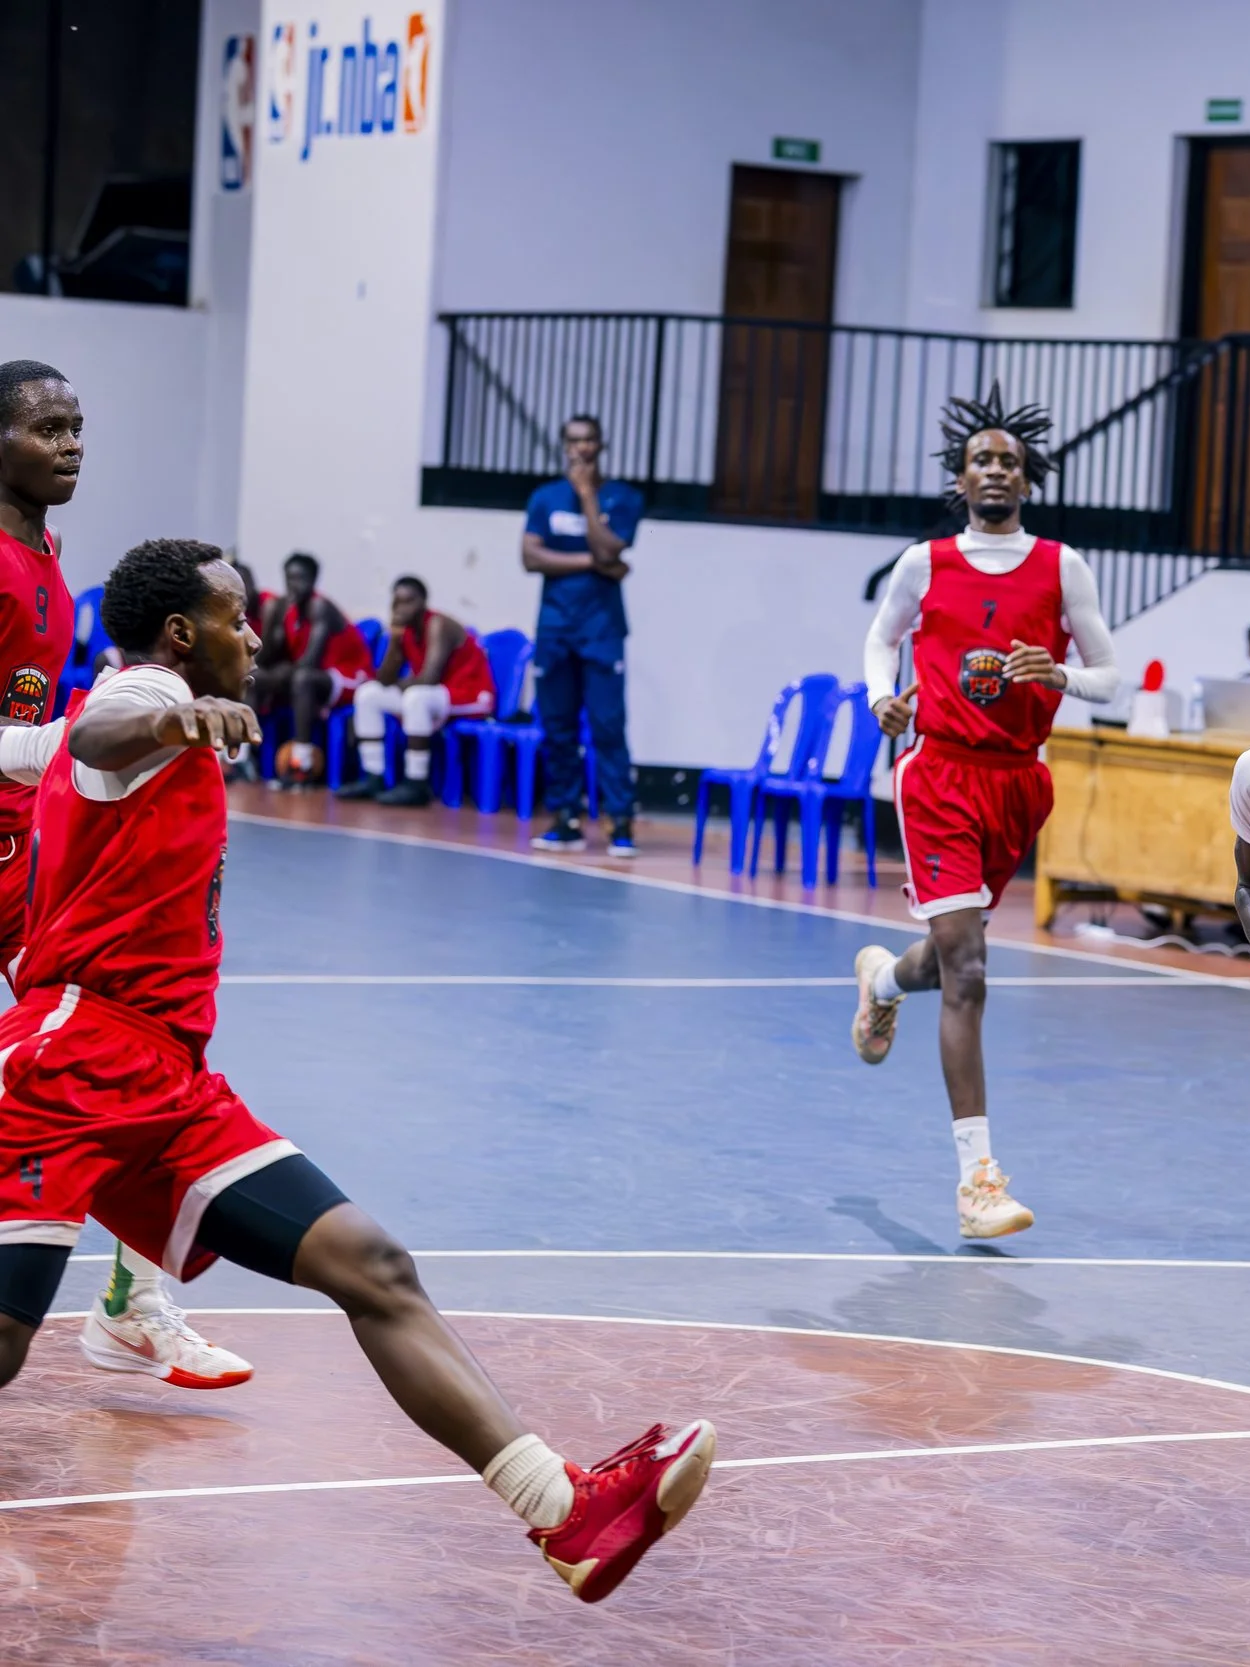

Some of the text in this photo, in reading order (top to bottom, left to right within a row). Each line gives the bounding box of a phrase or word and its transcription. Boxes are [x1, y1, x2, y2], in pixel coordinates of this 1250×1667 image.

[35, 585, 49, 635] 9
[982, 600, 997, 629] 7
[926, 854, 940, 882] 7
